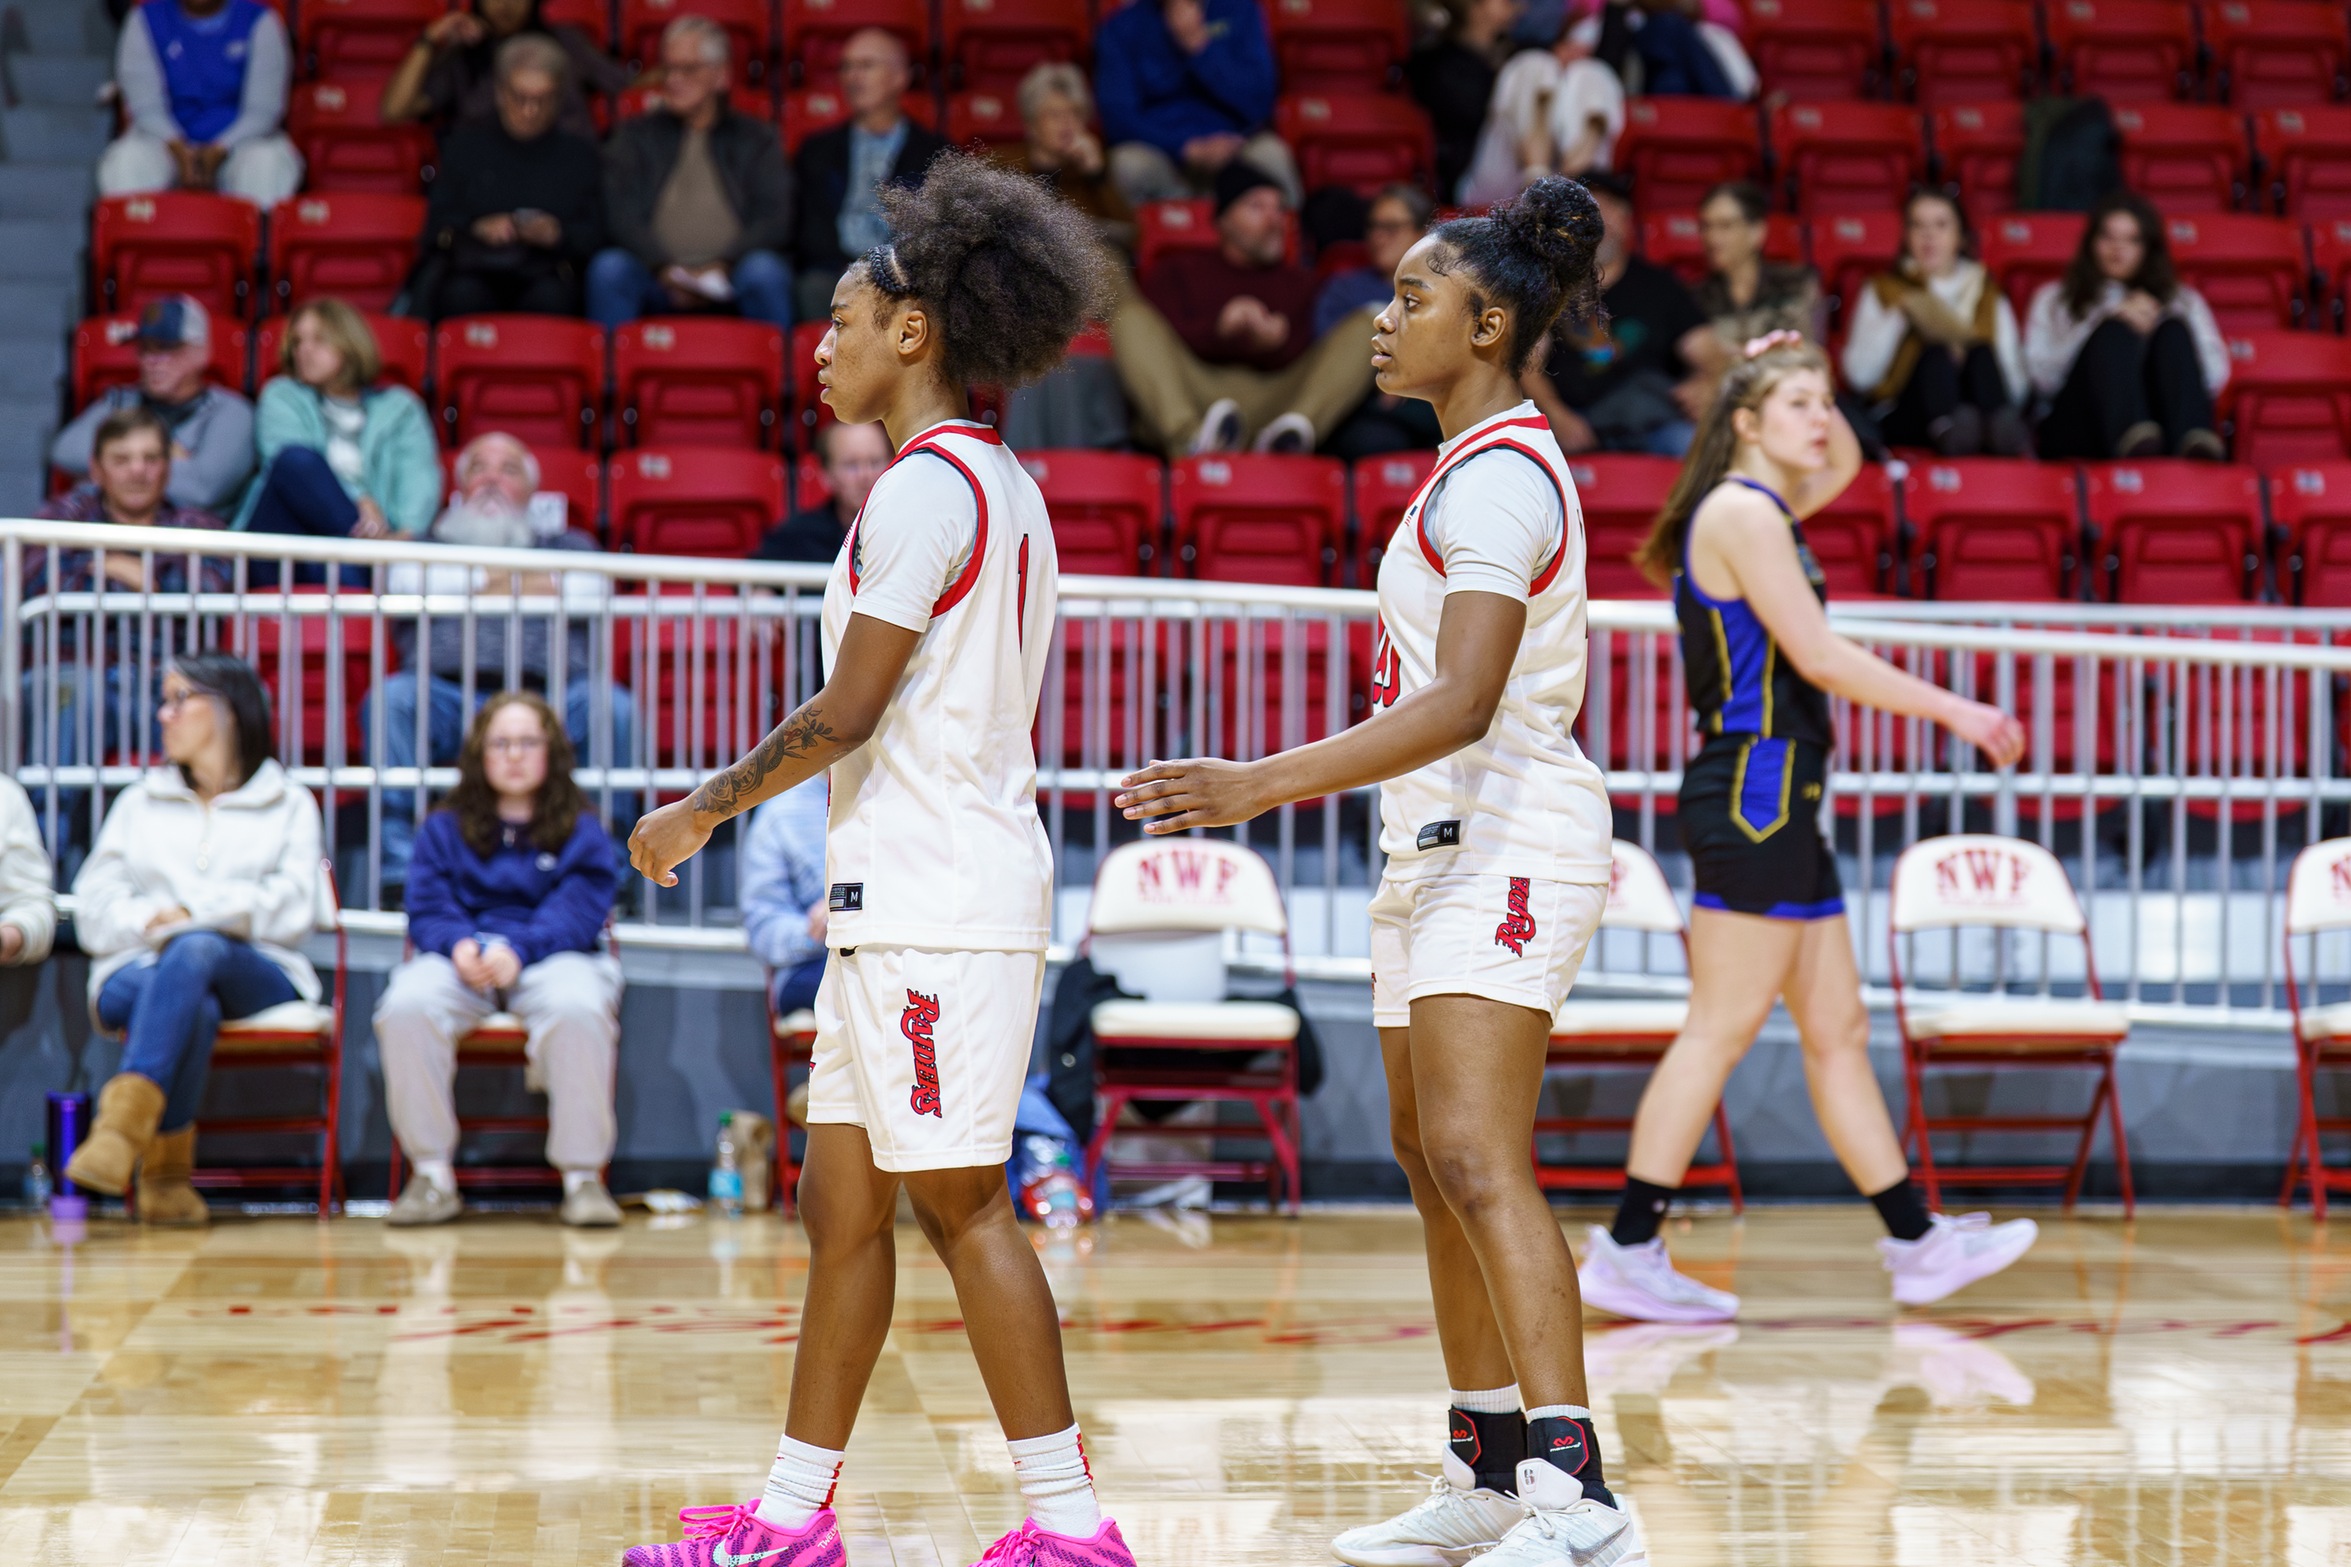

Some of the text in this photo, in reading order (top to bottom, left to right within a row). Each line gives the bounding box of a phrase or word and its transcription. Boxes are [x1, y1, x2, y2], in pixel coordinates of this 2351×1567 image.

[1443, 827, 1453, 838] M
[850, 891, 859, 903] M
[1495, 876, 1536, 958] RAIDE
[900, 988, 942, 1119] RAIDERS
